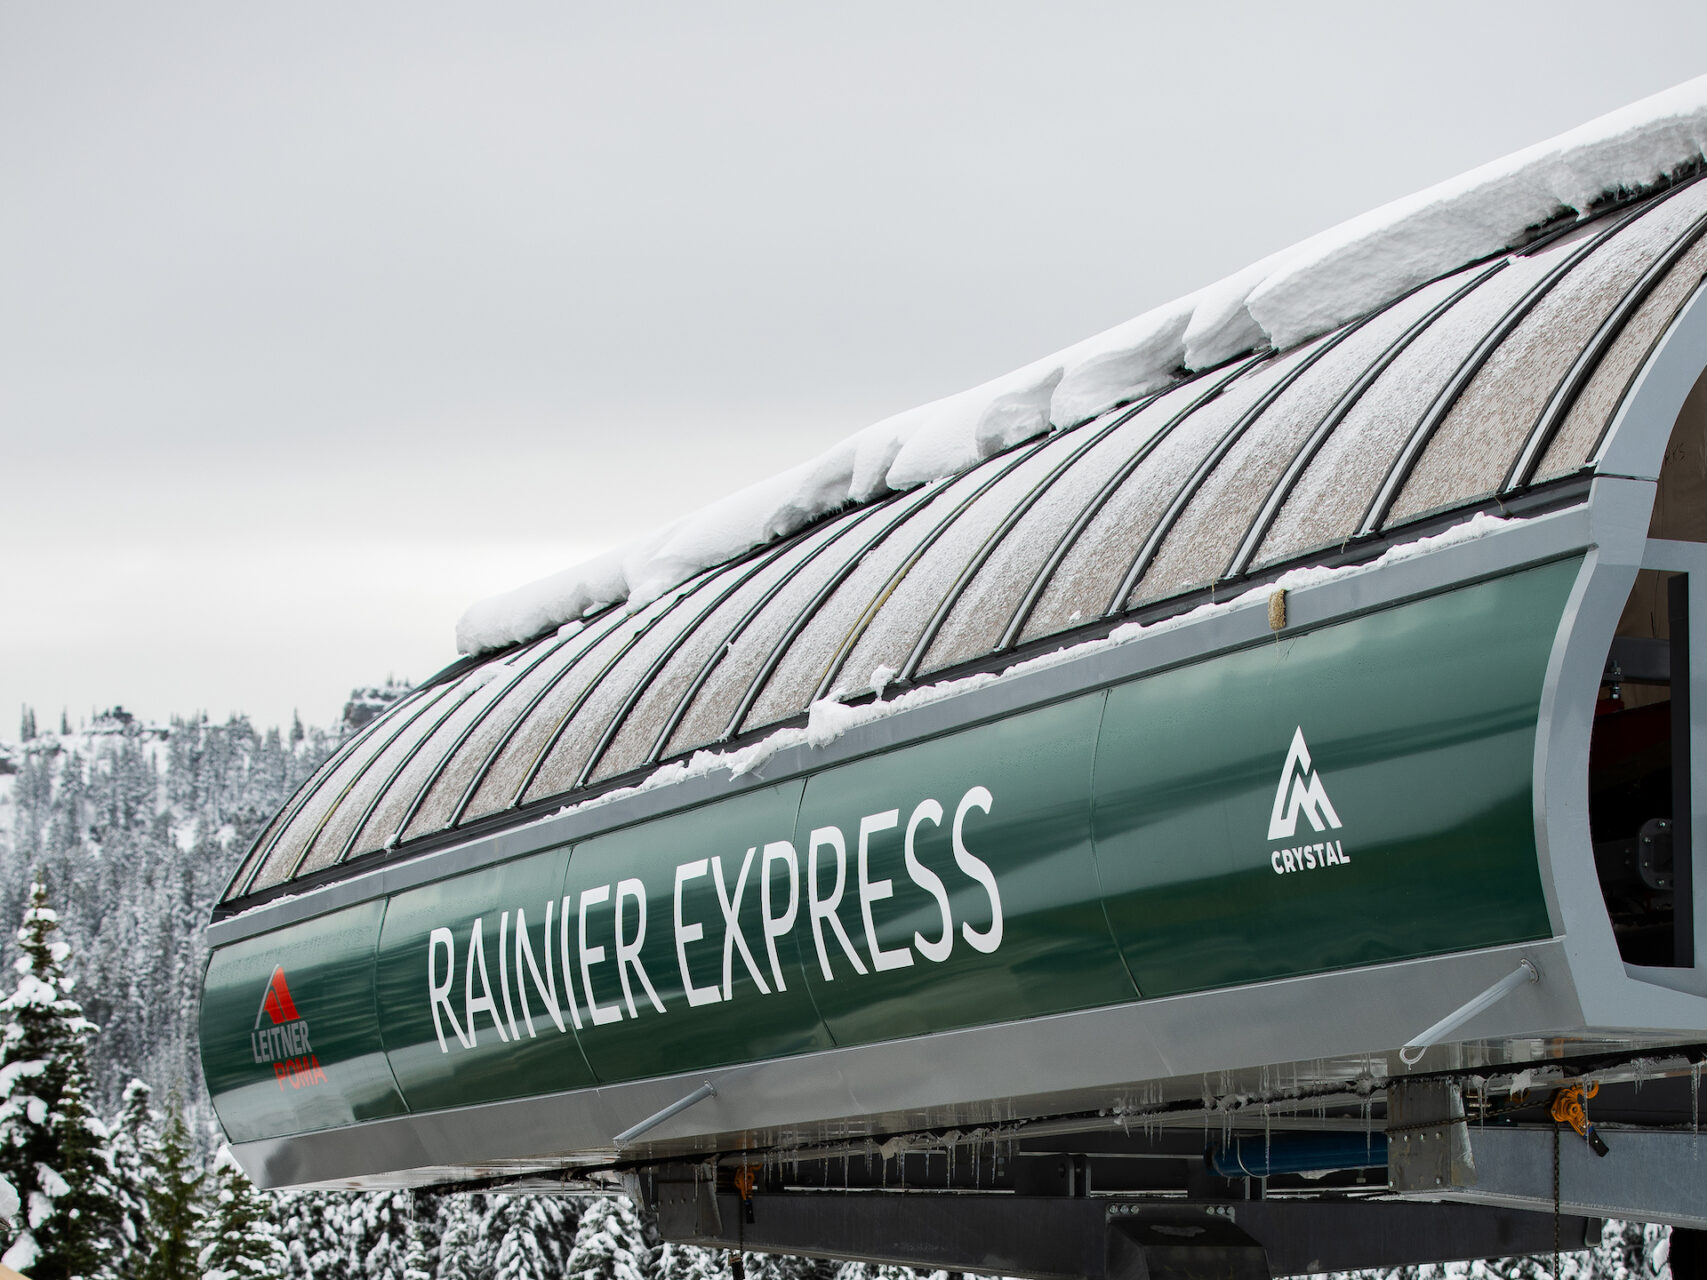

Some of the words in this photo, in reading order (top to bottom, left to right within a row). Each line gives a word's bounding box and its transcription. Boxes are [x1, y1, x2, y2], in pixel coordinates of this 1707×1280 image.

[1271, 840, 1350, 875] CRYSTAL
[428, 877, 667, 1054] RAINIER
[674, 785, 1003, 1007] EXPRESS
[251, 1020, 312, 1064] LEITNER
[273, 1054, 328, 1092] POMA
